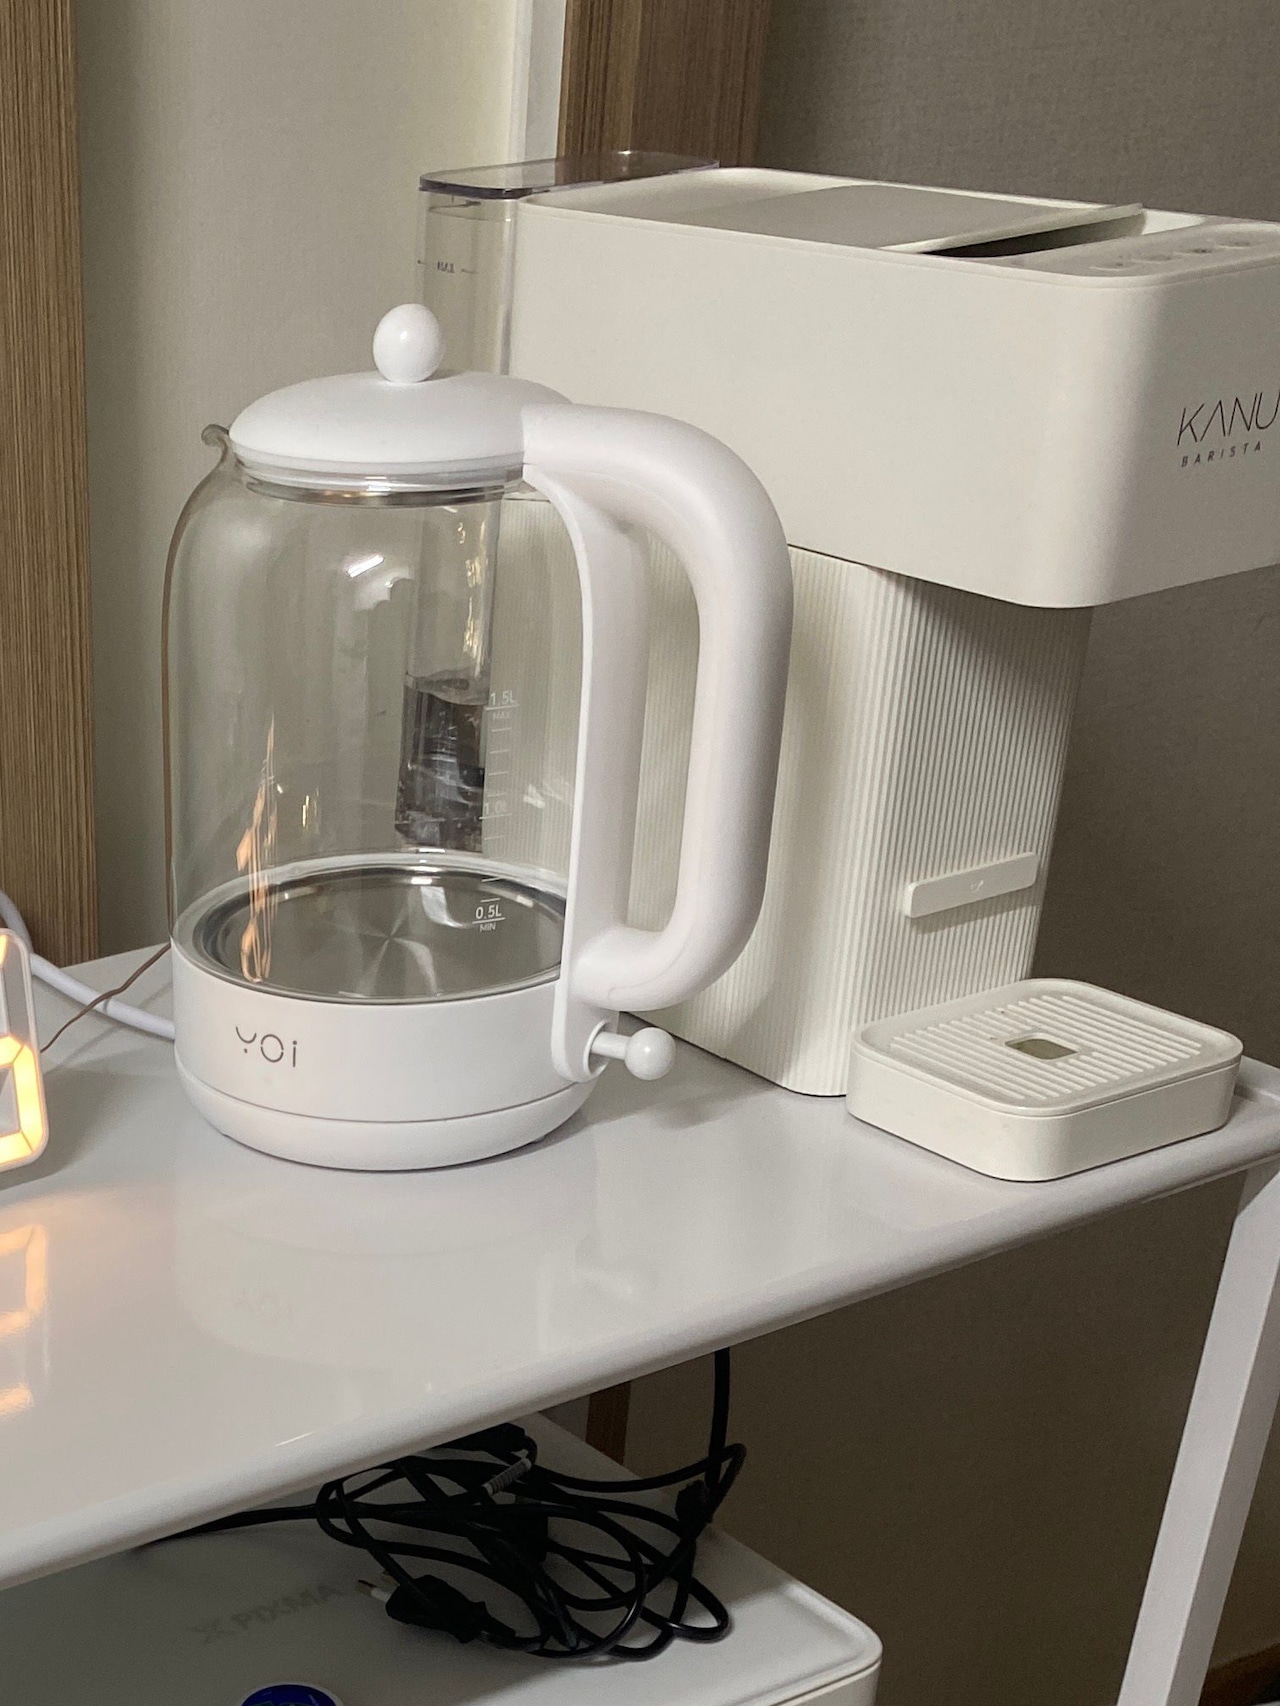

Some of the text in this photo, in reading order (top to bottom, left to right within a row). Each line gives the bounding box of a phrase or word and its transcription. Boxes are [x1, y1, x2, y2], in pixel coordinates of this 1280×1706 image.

[1176, 388, 1280, 446] KANU
[1181, 440, 1262, 468] BARISTA
[475, 904, 502, 919] 0.5L
[479, 922, 496, 932] MIN
